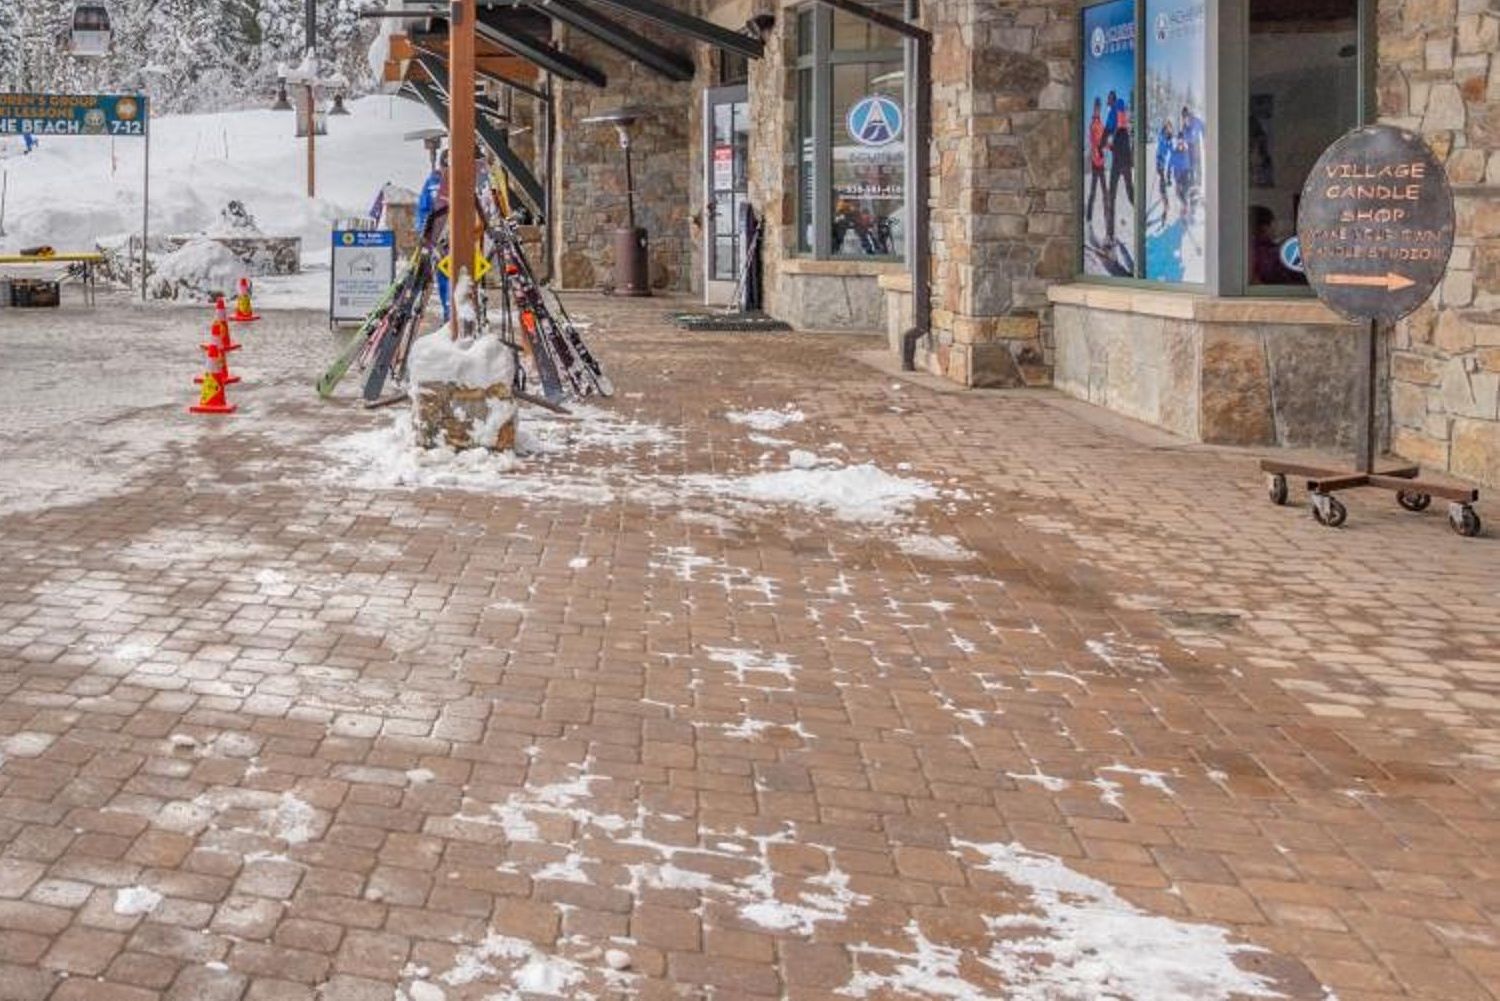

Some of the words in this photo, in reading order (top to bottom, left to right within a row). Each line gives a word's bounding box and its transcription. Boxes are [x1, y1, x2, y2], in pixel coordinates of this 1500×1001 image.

[51, 95, 97, 106] GROUP
[15, 106, 74, 119] LESSONS
[21, 119, 80, 134] BEACH
[111, 120, 143, 134] 7-12
[1325, 163, 1427, 179] VILLAGE
[1325, 184, 1421, 200] CANDLE
[1340, 208, 1405, 223] SHOP
